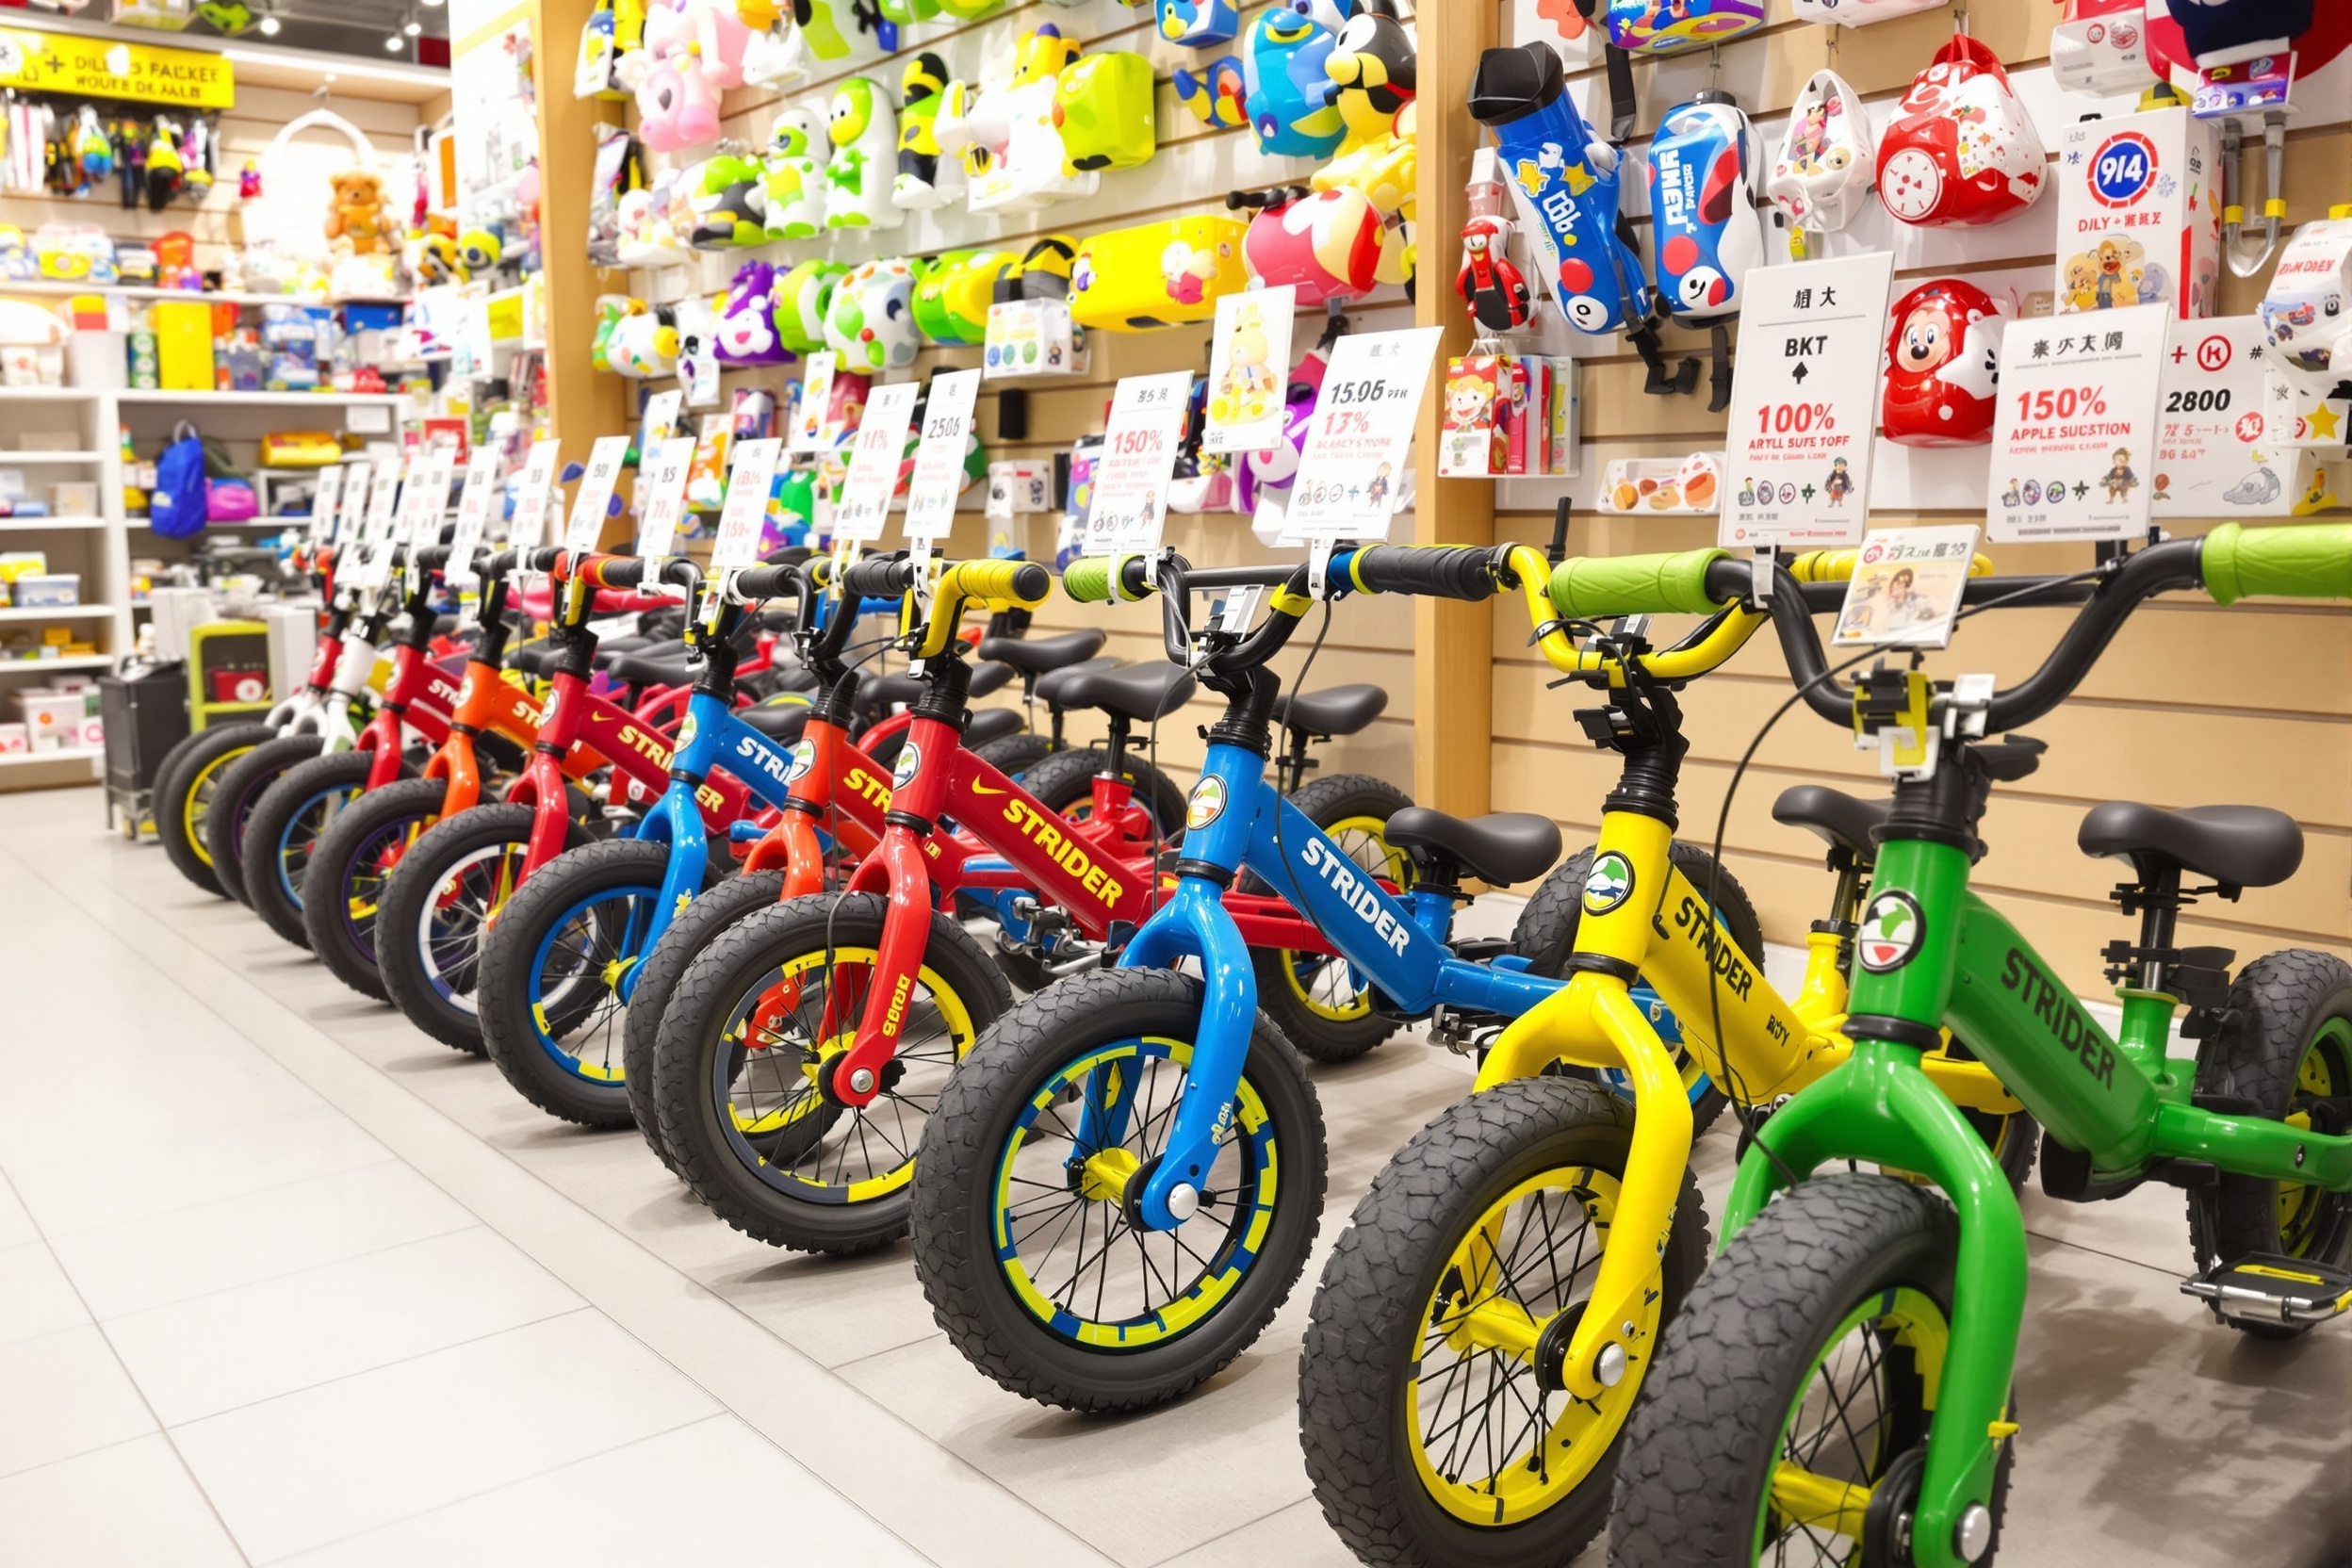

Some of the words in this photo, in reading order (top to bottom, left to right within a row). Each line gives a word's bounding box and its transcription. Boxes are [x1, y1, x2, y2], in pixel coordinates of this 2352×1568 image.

[2099, 154, 2144, 188] 914
[1785, 335, 1828, 357] BKT
[1757, 402, 1836, 433] 100%
[2017, 385, 2107, 421] 150%
[2165, 388, 2231, 413] 2800
[1114, 430, 1163, 454] 150%
[2010, 426, 2056, 442] APPLE
[736, 736, 791, 788] STRI
[1002, 798, 1123, 909] STRIDER
[1301, 837, 1411, 958] STRIDER
[2001, 947, 2115, 1091] STRIDER
